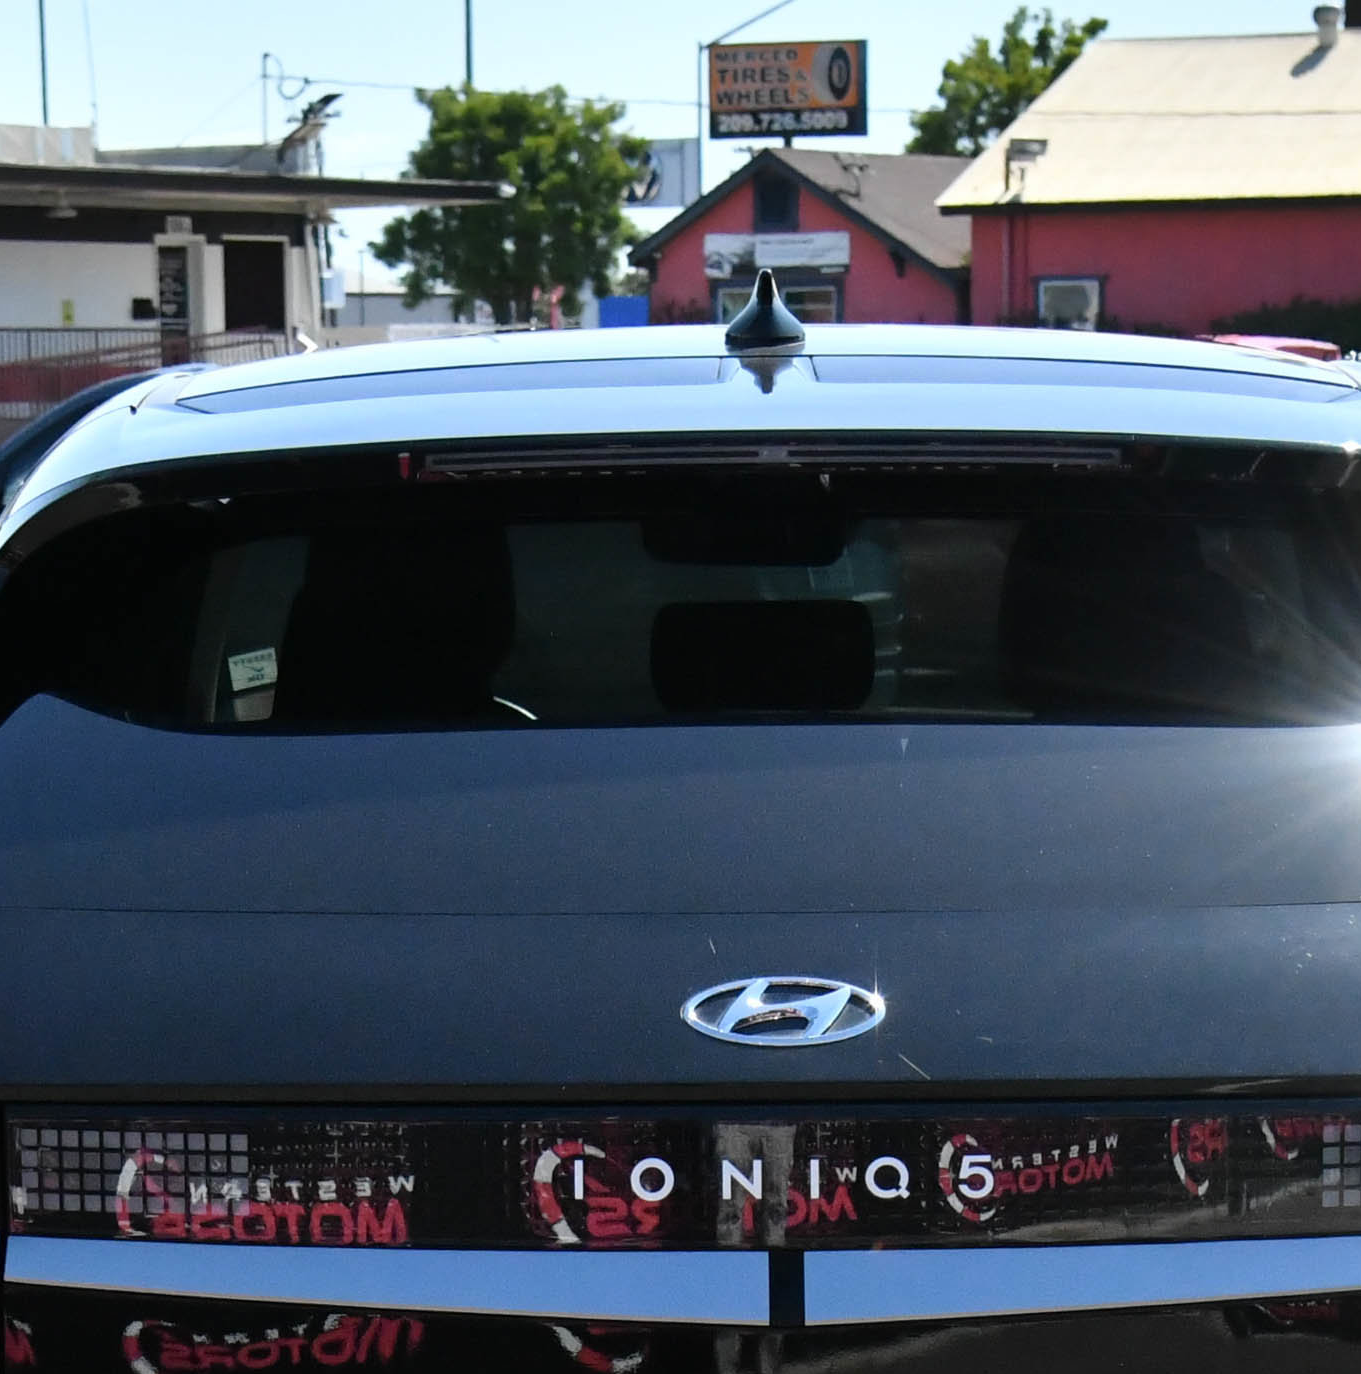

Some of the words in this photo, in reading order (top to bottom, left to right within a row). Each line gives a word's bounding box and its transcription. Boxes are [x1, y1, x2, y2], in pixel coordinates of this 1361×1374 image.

[715, 49, 798, 62] MERCED
[717, 68, 791, 84] TIRES
[716, 87, 810, 105] WHEELS
[573, 1156, 911, 1201] IONIQ
[957, 1154, 995, 1200] 5
